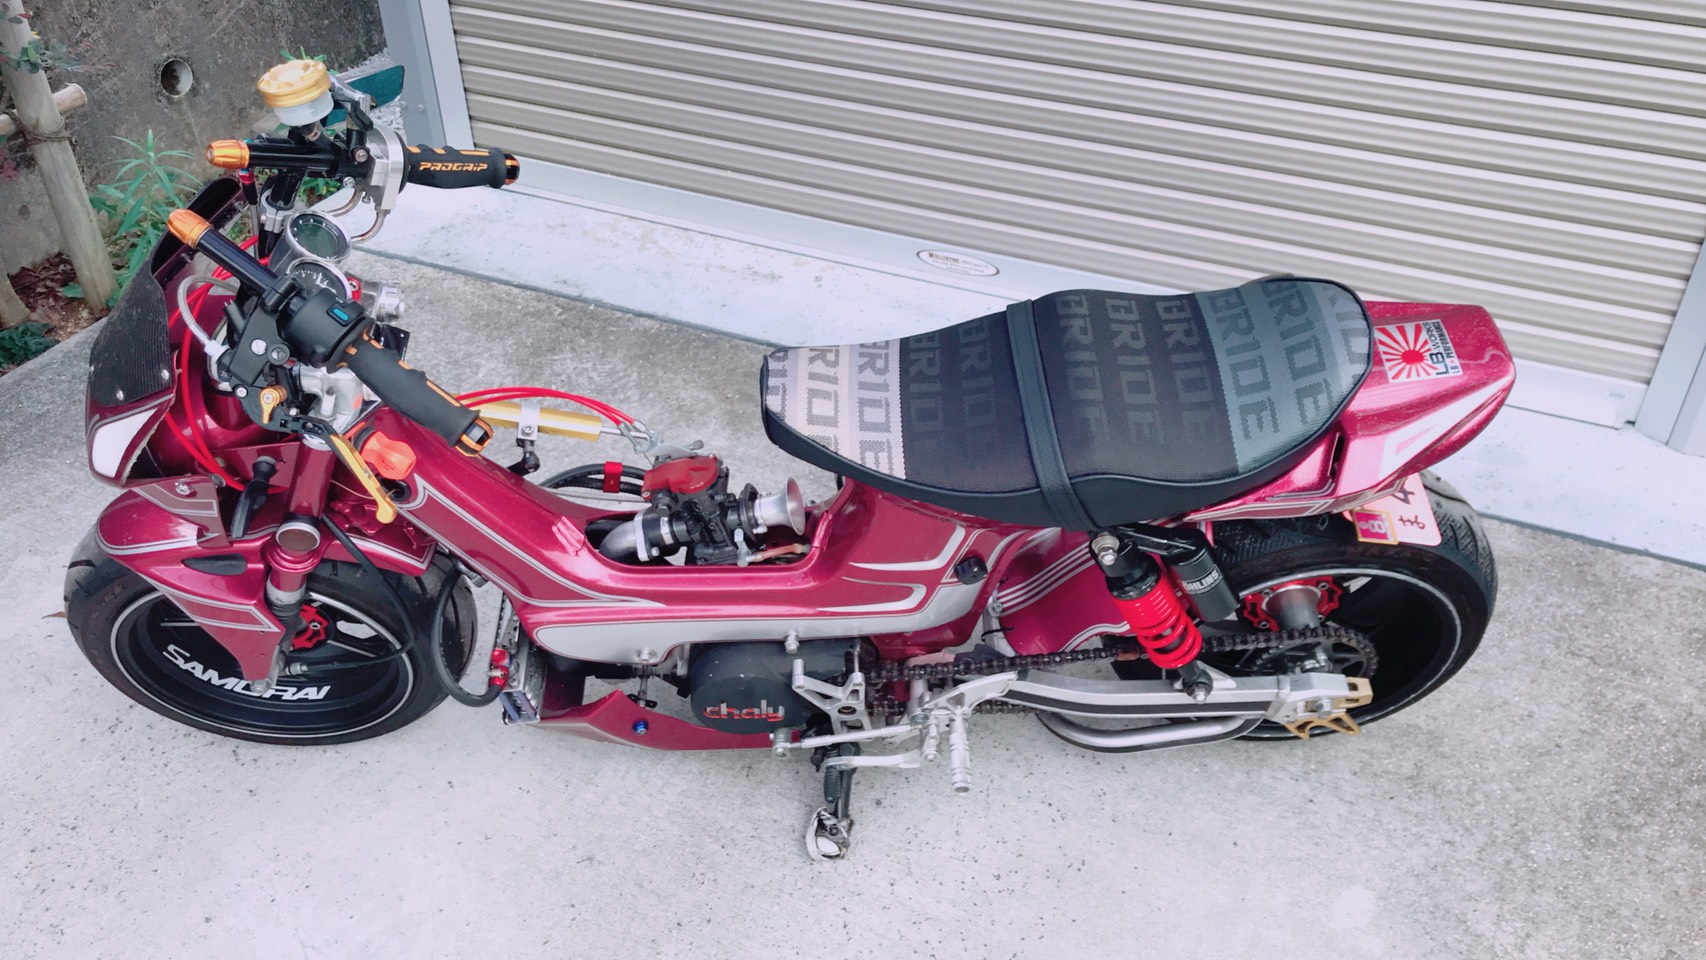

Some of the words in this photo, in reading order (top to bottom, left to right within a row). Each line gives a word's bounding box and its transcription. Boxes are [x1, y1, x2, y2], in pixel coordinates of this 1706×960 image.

[1105, 298, 1165, 444] BRIDE
[1207, 287, 1281, 441] BRIDE
[162, 643, 331, 701] SAMURAI
